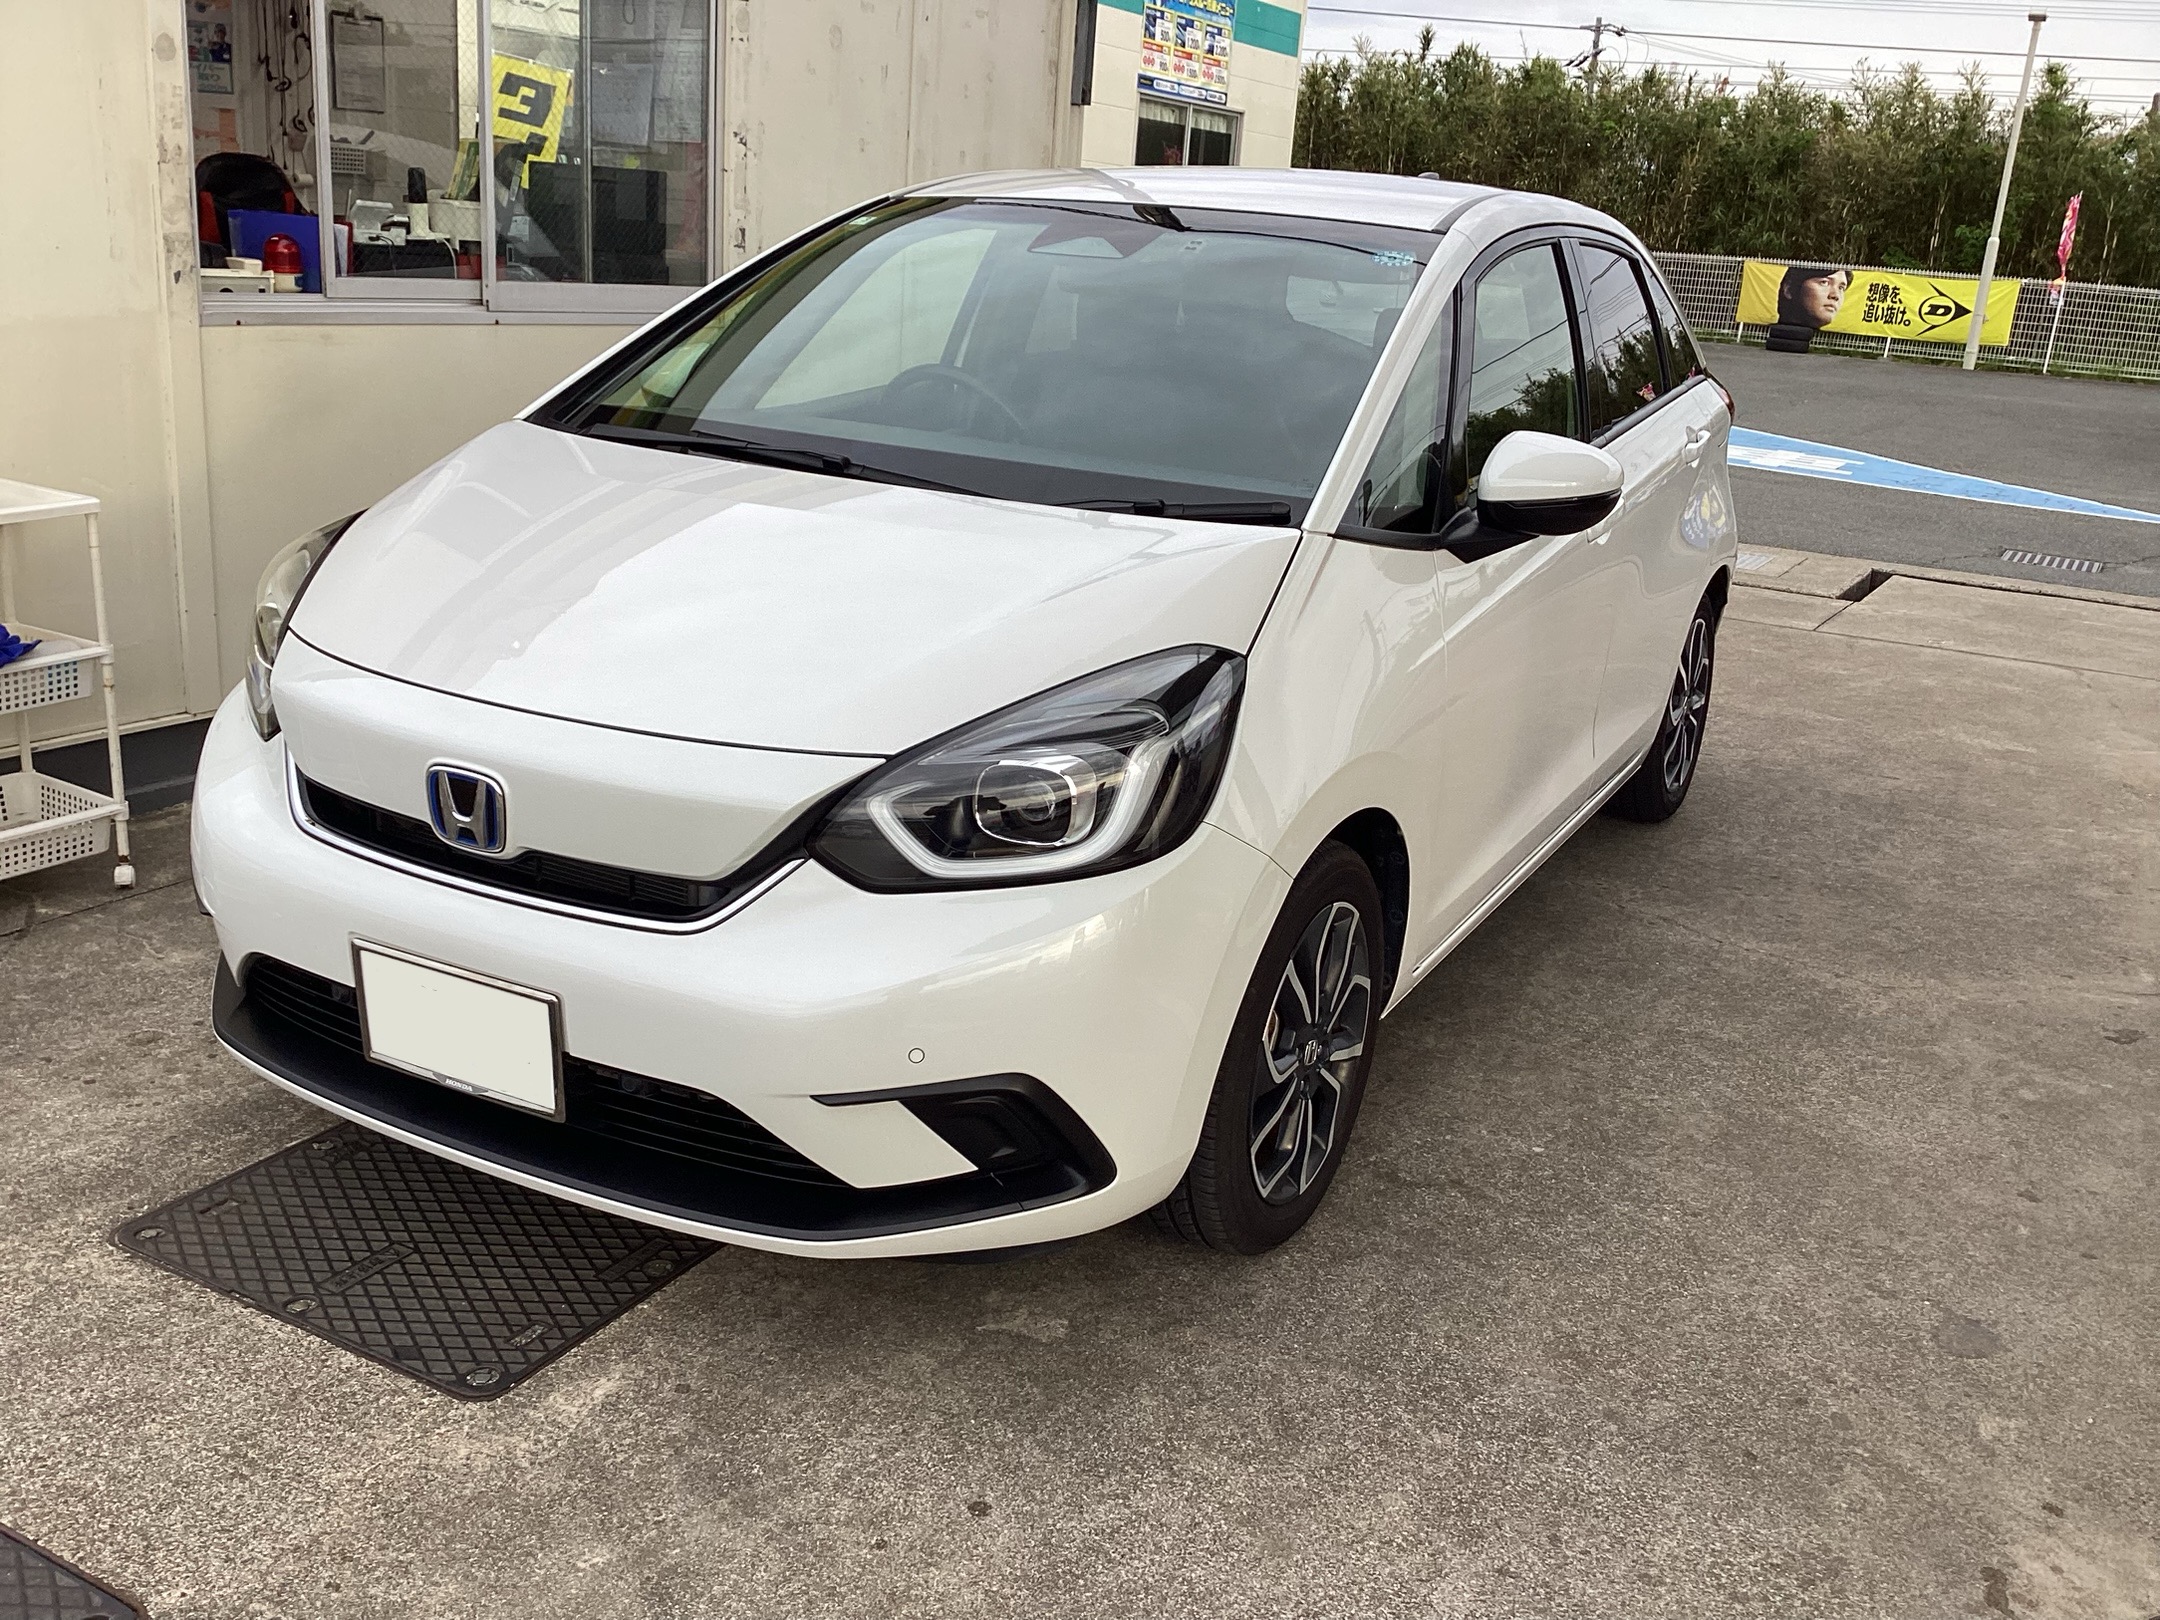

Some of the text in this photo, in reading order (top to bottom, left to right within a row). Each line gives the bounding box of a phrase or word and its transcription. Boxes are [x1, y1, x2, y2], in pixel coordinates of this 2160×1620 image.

[1862, 303, 1911, 327] 追い抜け。
[445, 1078, 473, 1092] HONDA
